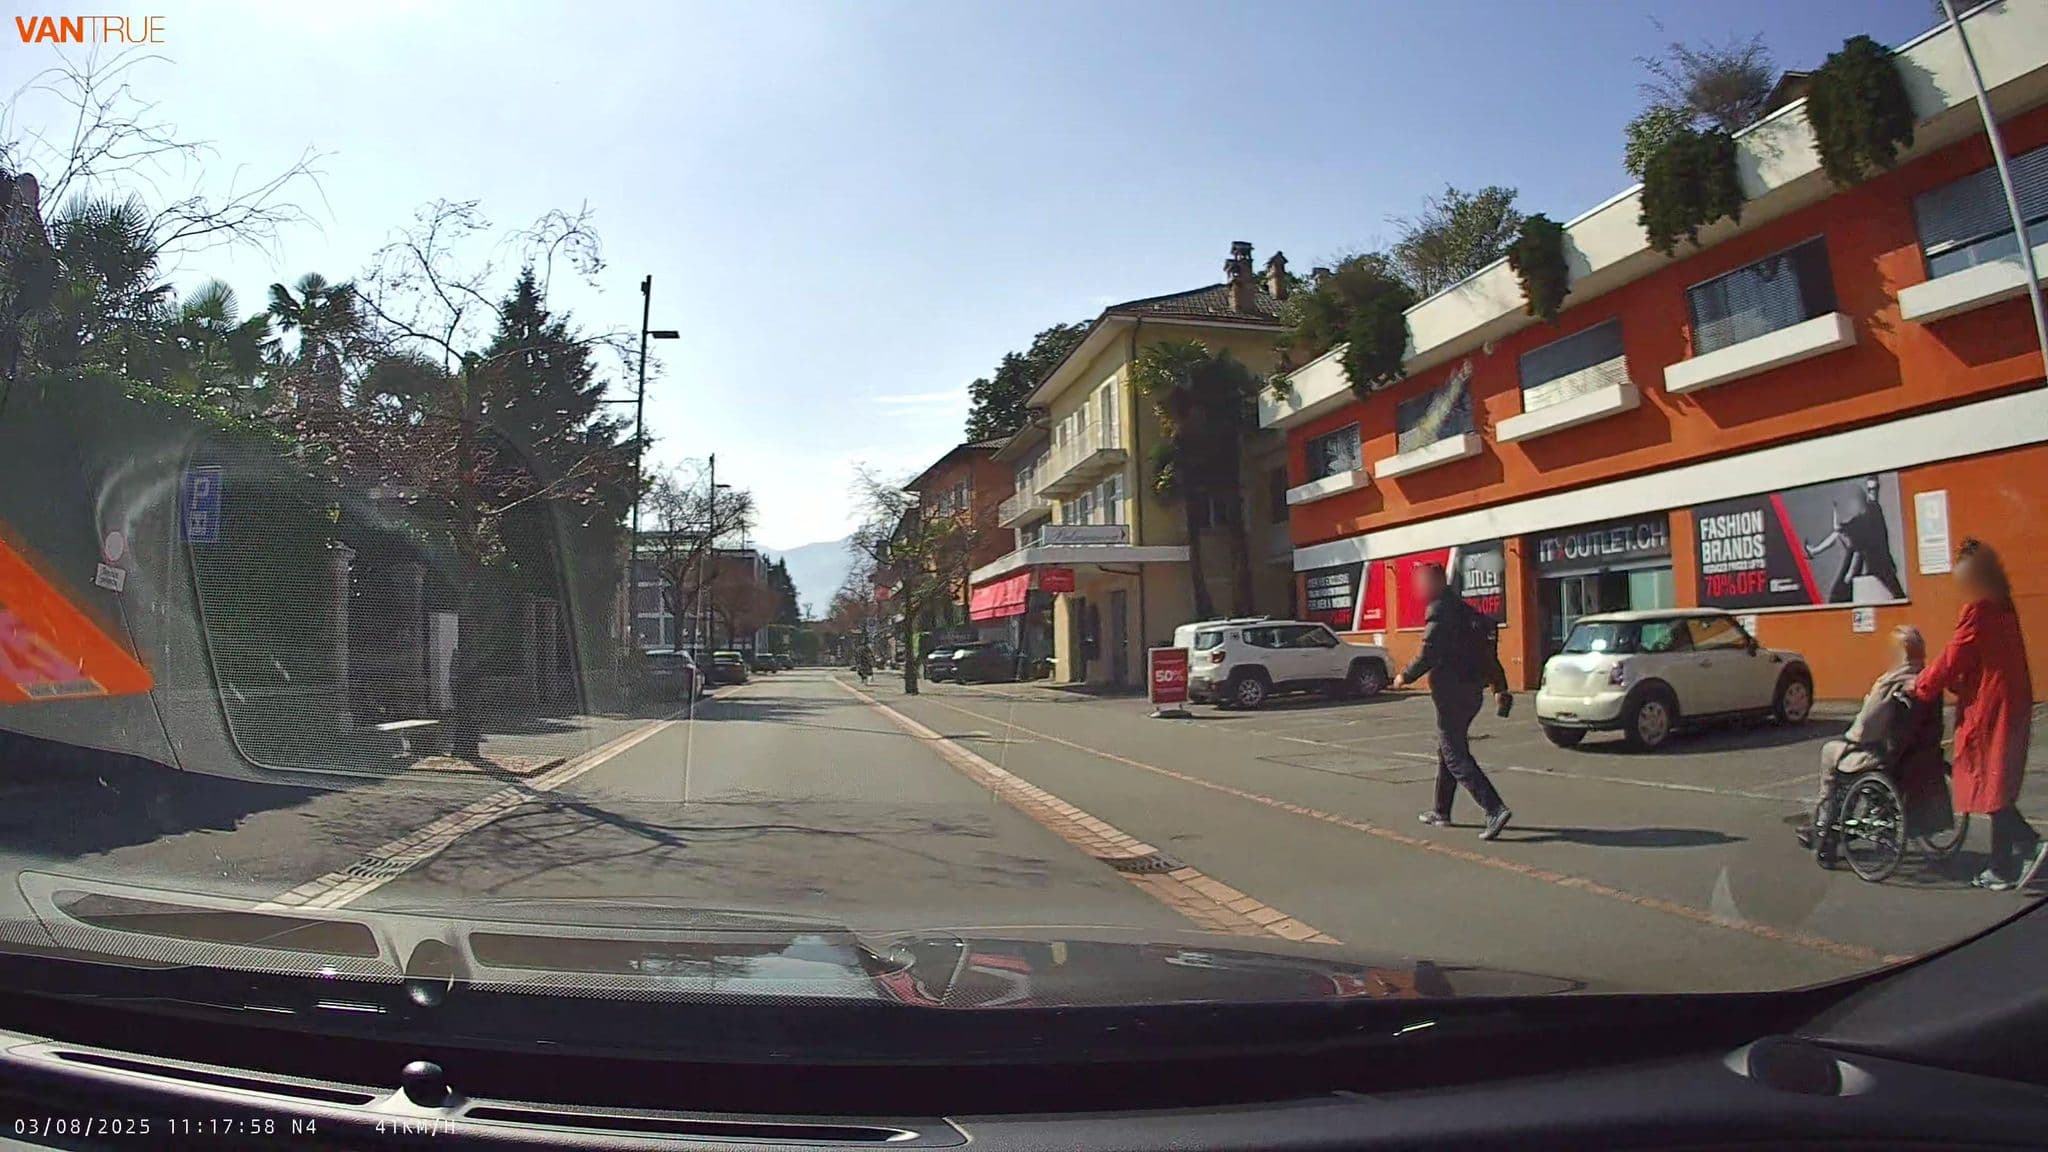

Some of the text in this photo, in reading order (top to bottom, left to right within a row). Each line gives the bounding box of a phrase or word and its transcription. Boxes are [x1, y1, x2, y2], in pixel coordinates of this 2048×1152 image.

[193, 476, 210, 509] P
[1700, 510, 1764, 540] FASHION
[1702, 534, 1764, 564] BRANDS
[1705, 574, 1736, 598] 70%
[1737, 570, 1765, 595] OFF
[1155, 670, 1184, 682] 50%
